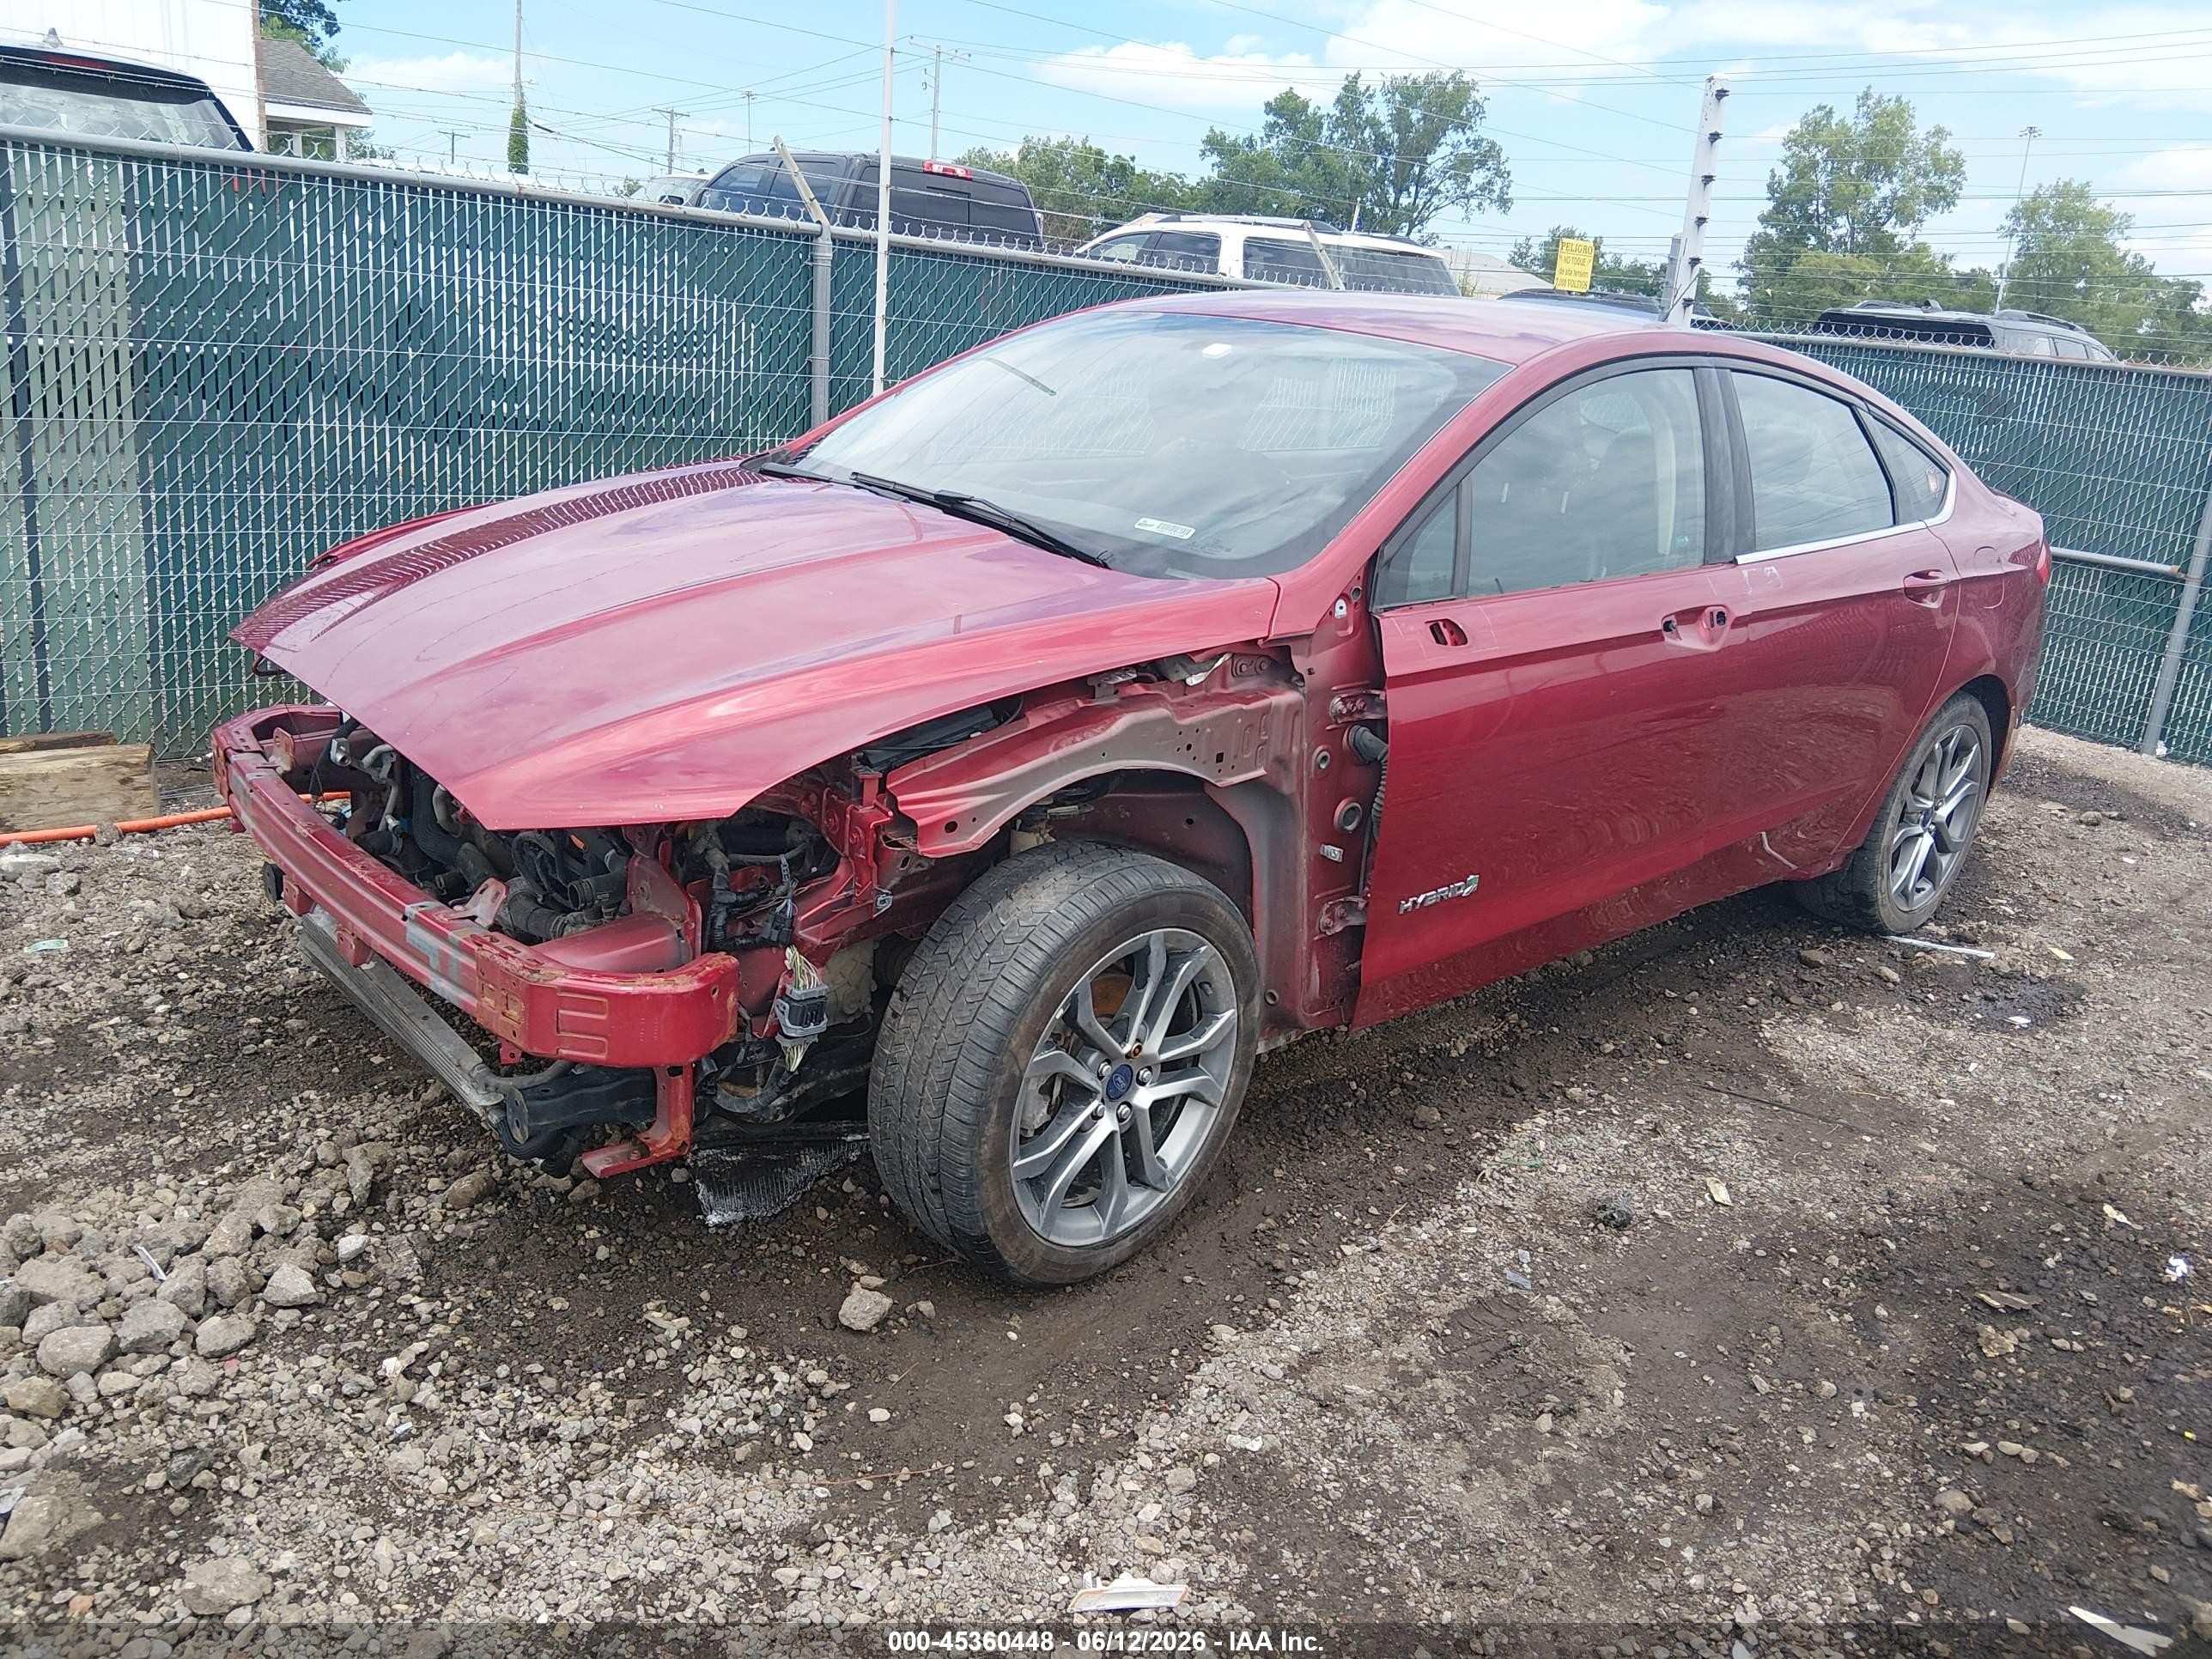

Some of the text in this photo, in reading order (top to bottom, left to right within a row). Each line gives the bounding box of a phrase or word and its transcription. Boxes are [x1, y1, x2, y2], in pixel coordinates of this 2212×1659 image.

[1561, 241, 1593, 255] PELIGRO
[1564, 256, 1571, 264] NO
[1399, 882, 1466, 915] HYBRID
